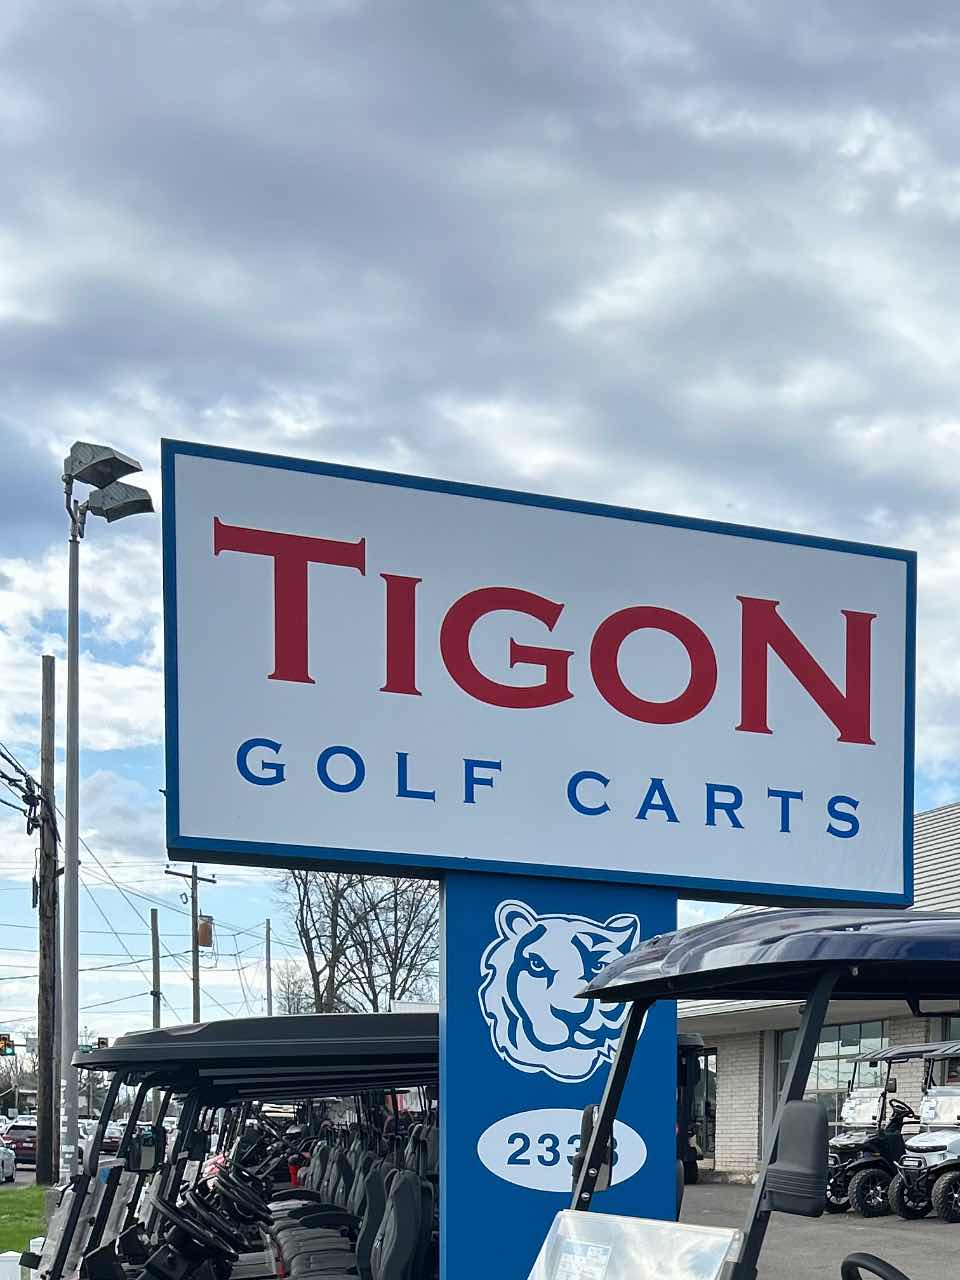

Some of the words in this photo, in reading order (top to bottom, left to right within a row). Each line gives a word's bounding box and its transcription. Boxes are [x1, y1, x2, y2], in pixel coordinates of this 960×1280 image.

[213, 516, 877, 746] TIGON
[236, 737, 502, 805] GOLF
[567, 770, 861, 840] CARTS
